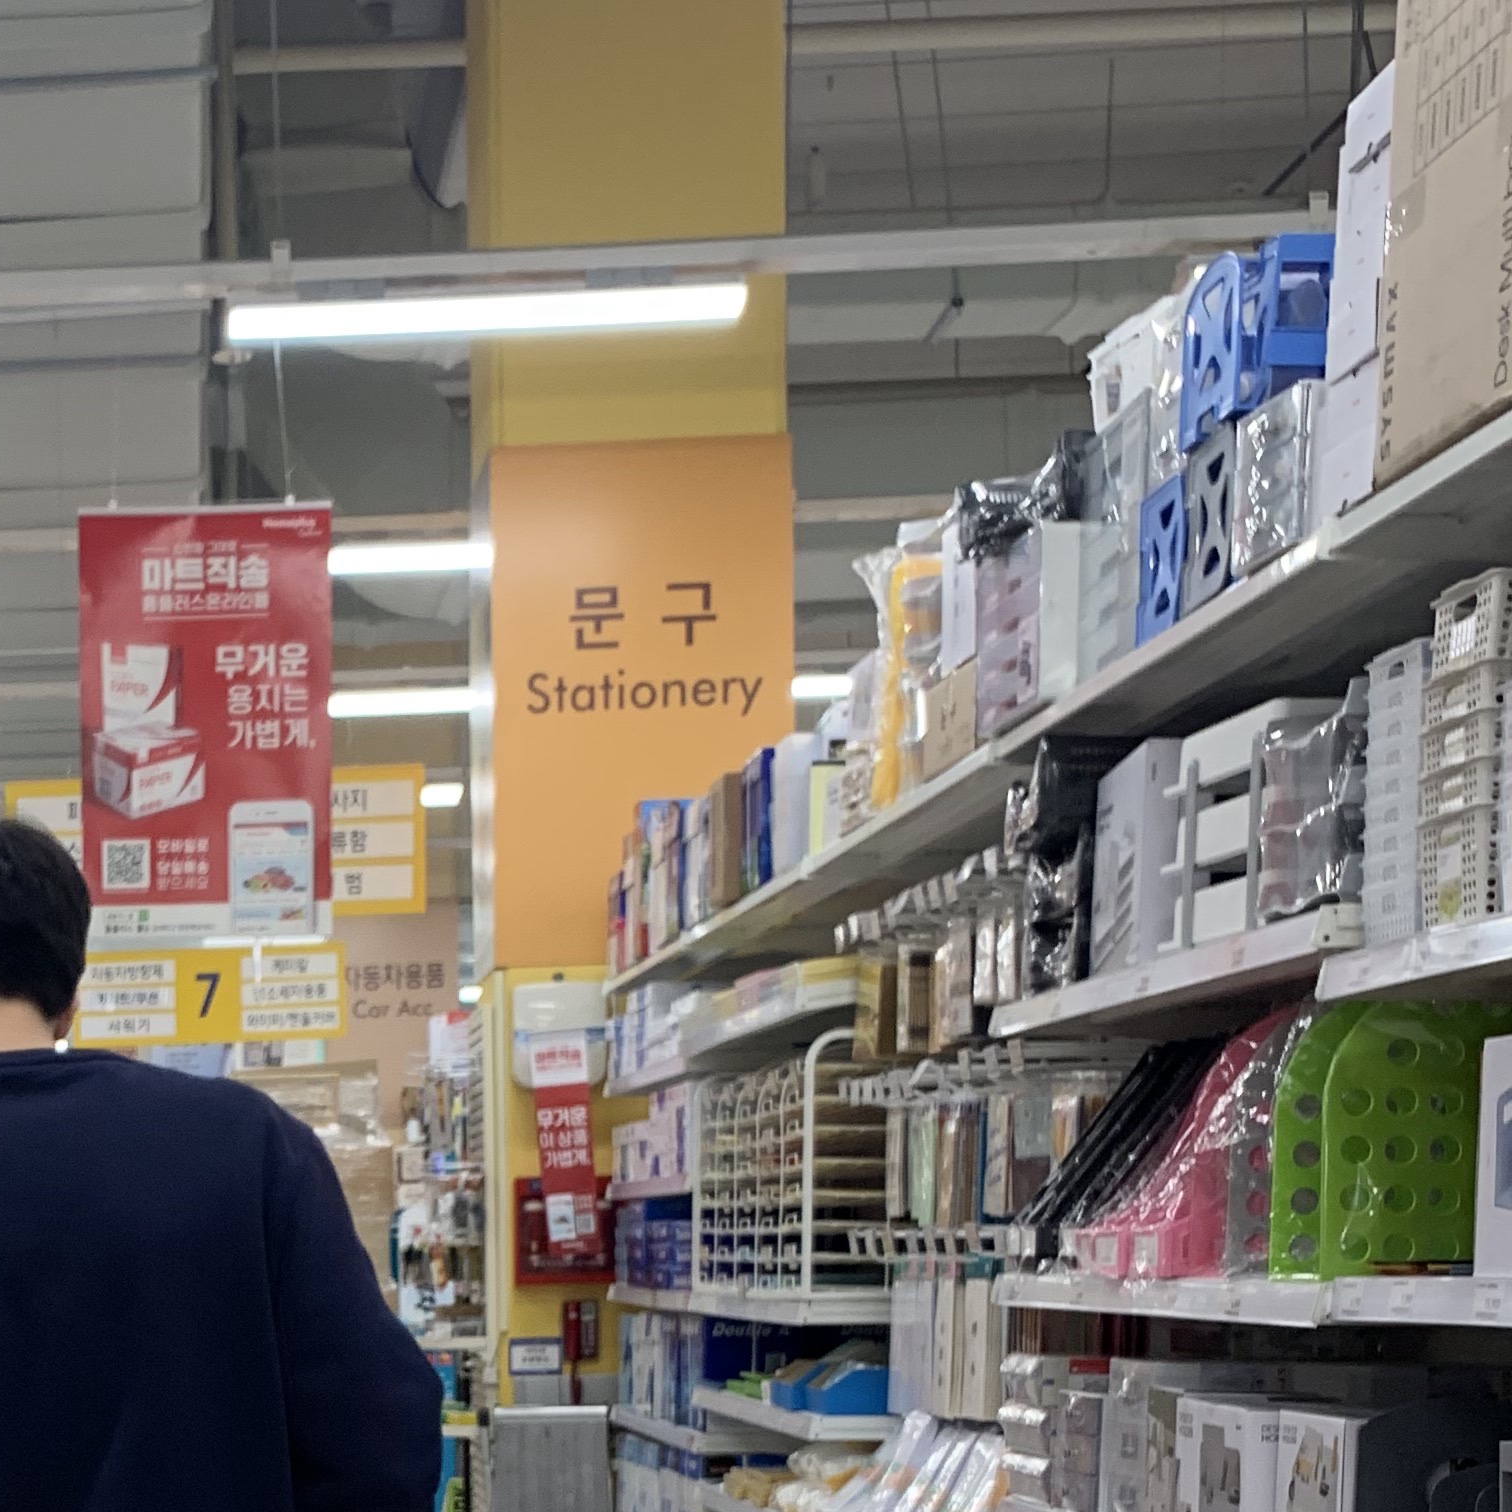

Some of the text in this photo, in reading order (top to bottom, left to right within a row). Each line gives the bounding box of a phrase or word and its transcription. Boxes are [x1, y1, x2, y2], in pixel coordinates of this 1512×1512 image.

[141, 555, 270, 592] 마트직송
[214, 642, 310, 679] 무거운
[226, 681, 309, 714] 용지는
[526, 668, 763, 717] Stationery
[228, 718, 317, 750] 가볍게.
[196, 972, 221, 1019] 7
[352, 1000, 389, 1019] Car
[536, 1106, 588, 1128] 무거운
